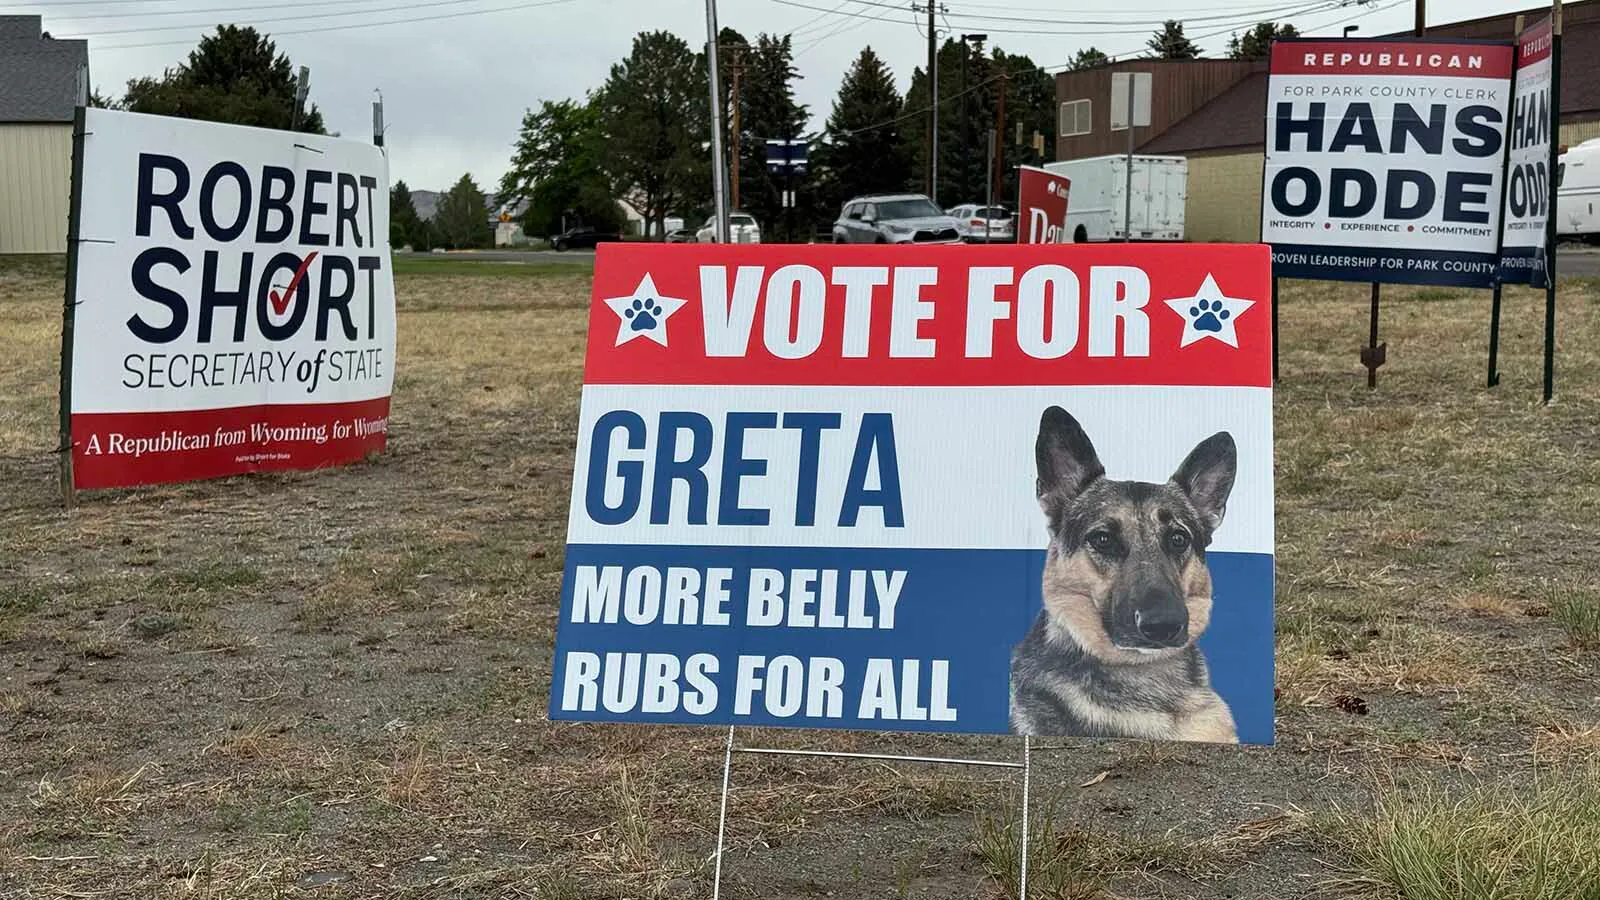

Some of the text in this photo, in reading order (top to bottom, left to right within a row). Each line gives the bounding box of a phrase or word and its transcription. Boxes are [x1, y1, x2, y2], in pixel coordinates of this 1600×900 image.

[1304, 53, 1483, 70] REPUBLICAN
[1284, 86, 1497, 101] FOR PARK COUNTY CLERK
[1512, 87, 1549, 150] HAN
[1274, 101, 1503, 158] HANS
[135, 152, 377, 249] ROBERT
[1270, 166, 1493, 225] ODDE
[1509, 161, 1547, 218] ODD
[1269, 220, 1492, 237] INTEGRITY EXPERIENCE COMMITMENT
[1271, 252, 1496, 274] ROVEN LEADERSHIP FOR PARK COUNTY
[126, 246, 381, 344] SHORT
[699, 263, 1152, 359] VOTE FOR
[122, 348, 383, 393] SECRETARY of STATE
[84, 433, 103, 456] A
[108, 430, 210, 458] Republican
[214, 427, 246, 447] from
[250, 422, 329, 445] Wyoming,
[332, 420, 352, 440] for
[584, 409, 905, 529] GRETA
[571, 565, 908, 630] MORE BELLY
[561, 652, 958, 723] RUBS FOR ALL
